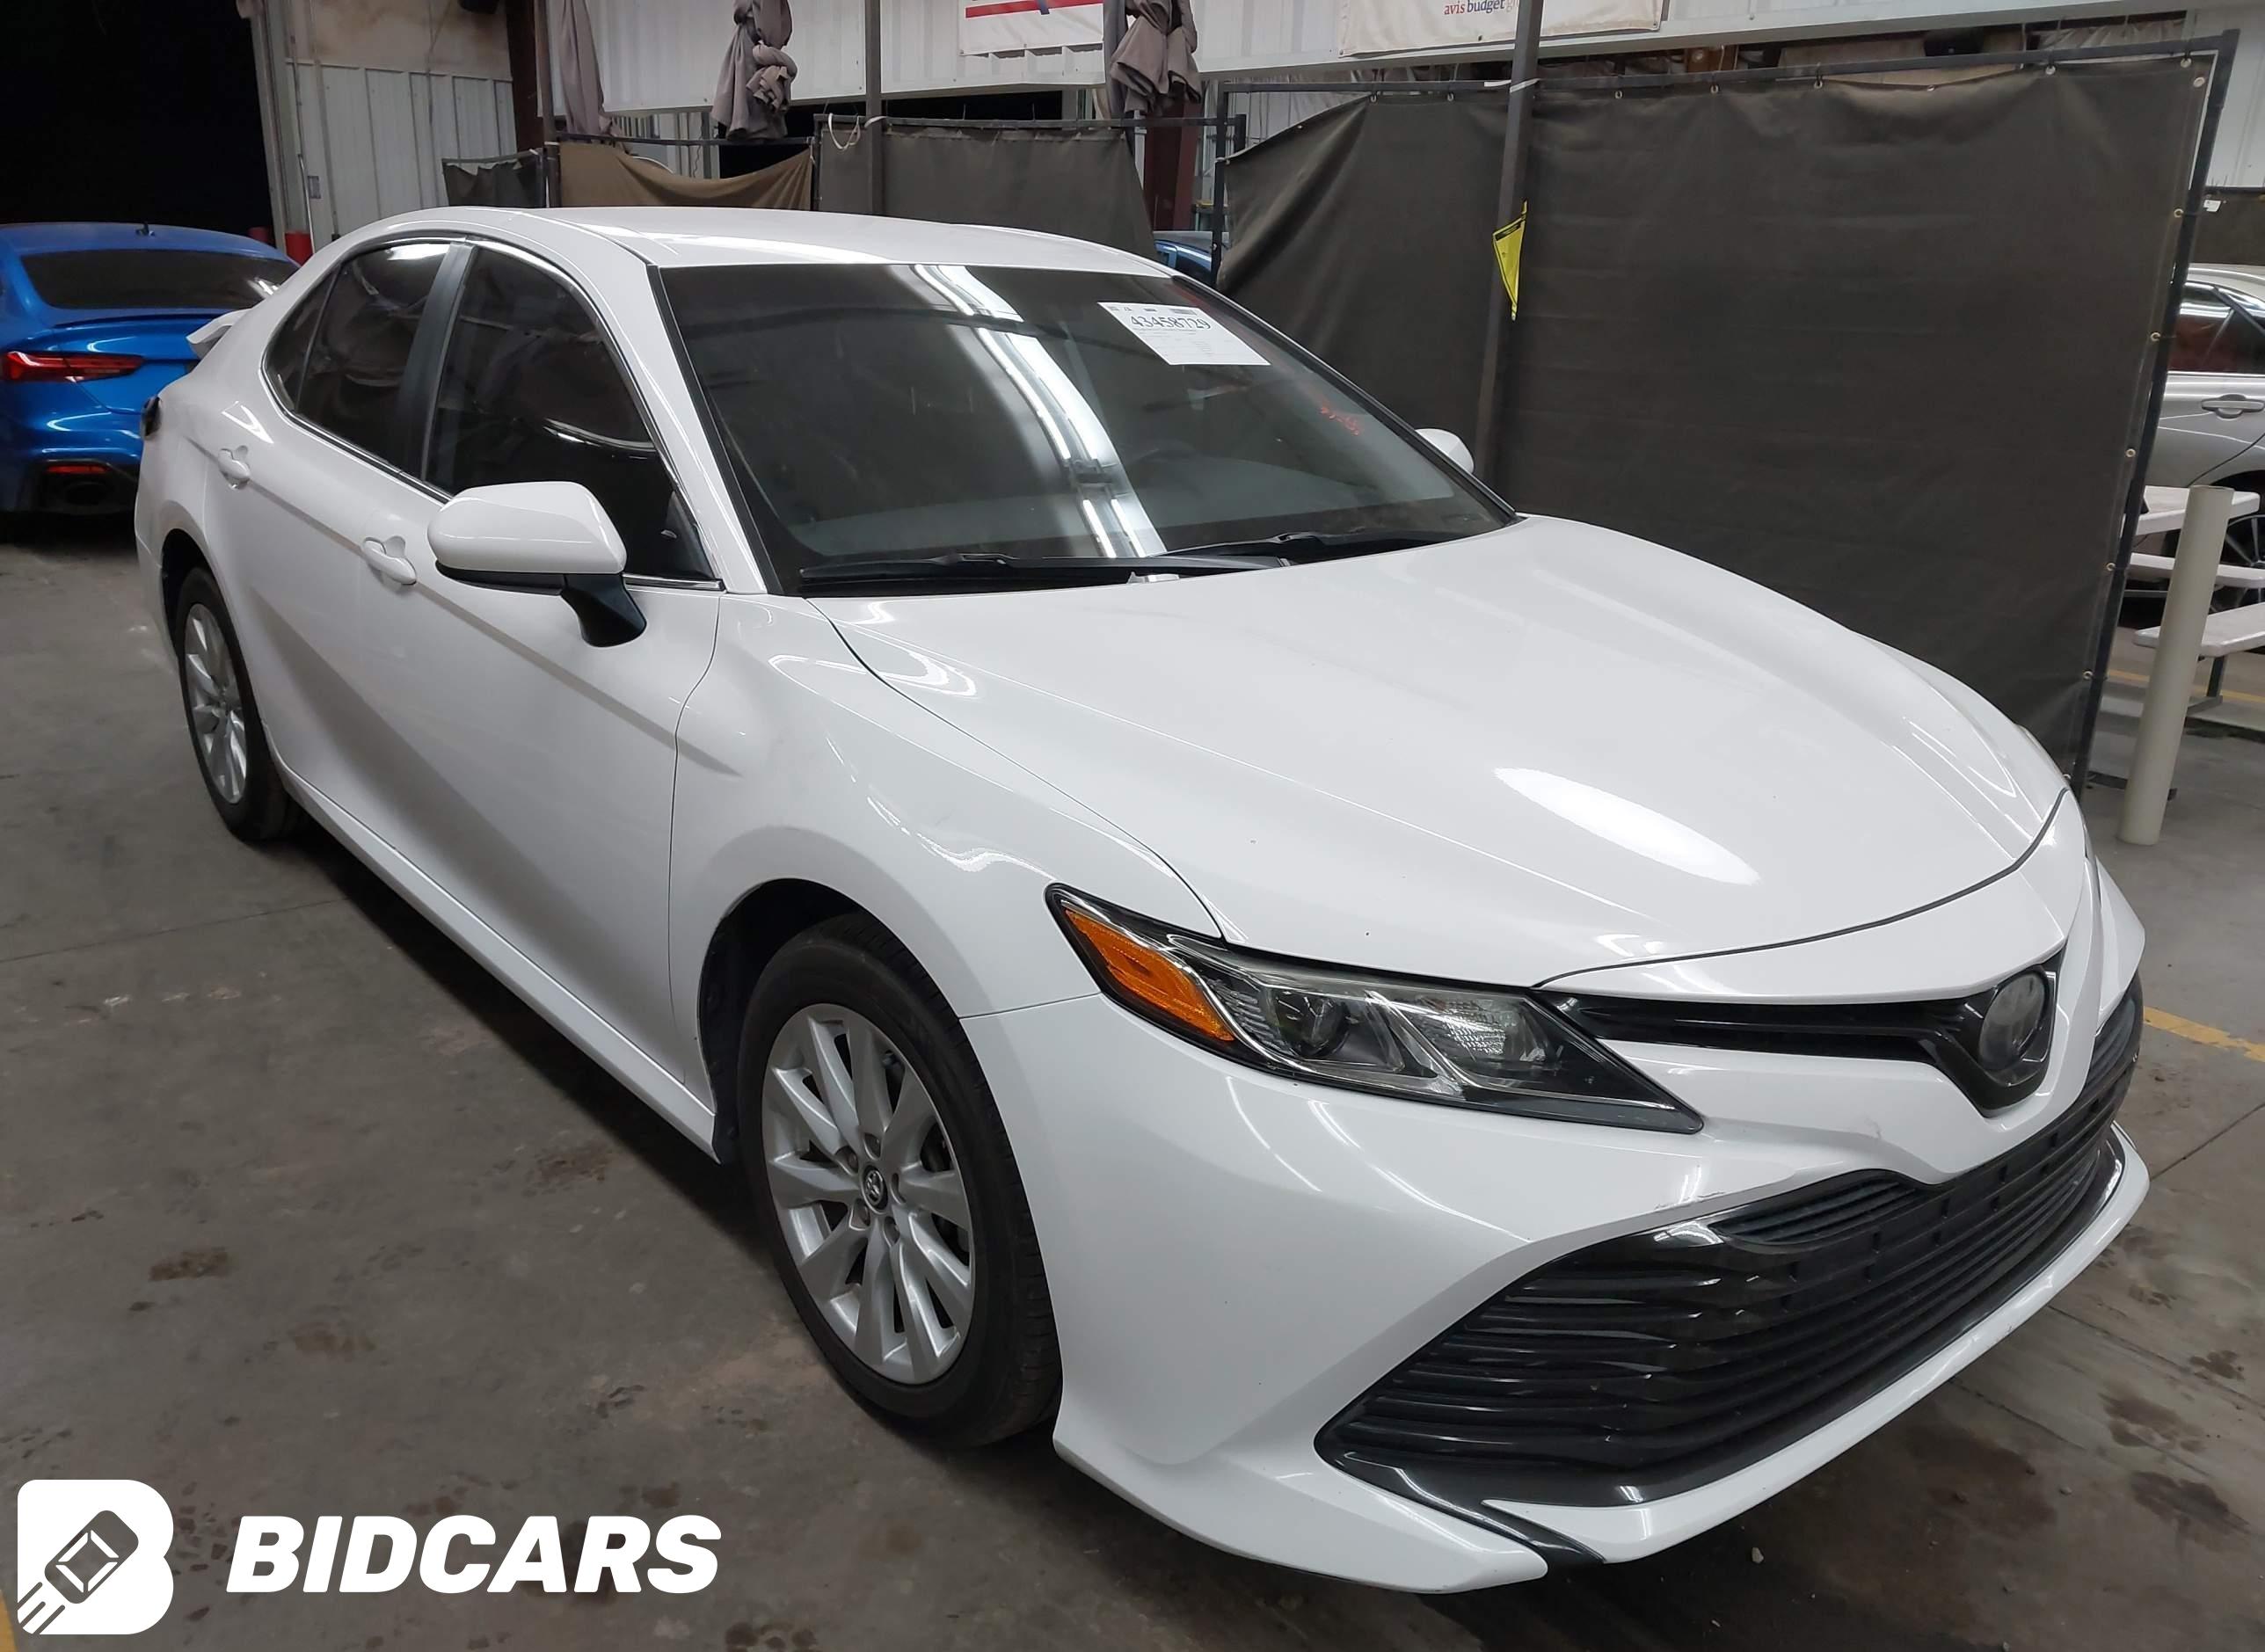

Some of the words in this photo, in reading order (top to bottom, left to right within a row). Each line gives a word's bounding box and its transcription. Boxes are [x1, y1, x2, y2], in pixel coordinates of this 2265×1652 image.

[1444, 1, 1465, 15] avis
[1467, 0, 1505, 14] budget
[1131, 316, 1211, 330] 43458729
